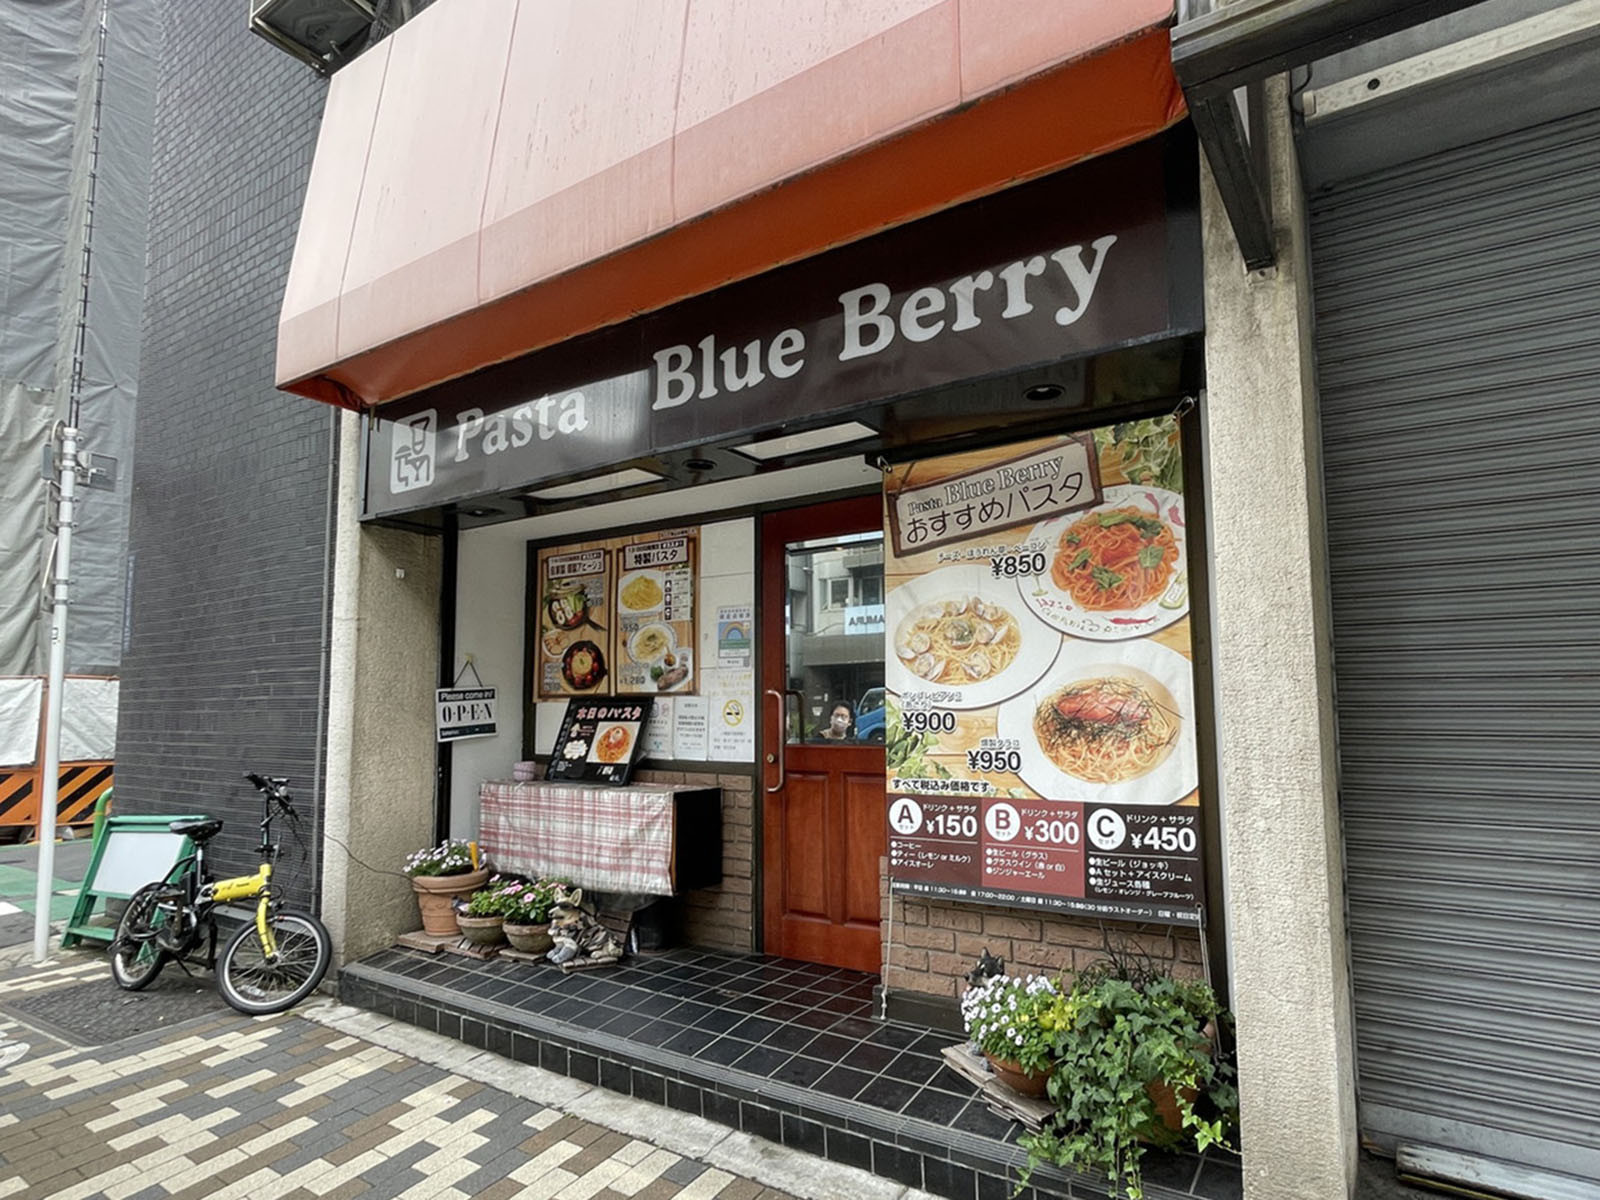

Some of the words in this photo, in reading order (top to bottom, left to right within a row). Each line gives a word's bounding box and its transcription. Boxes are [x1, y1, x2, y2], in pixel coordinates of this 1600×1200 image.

[455, 392, 589, 462] Pasta
[652, 328, 805, 411] Blue
[838, 234, 1118, 361] Berry
[907, 497, 943, 516] Pasta
[944, 479, 995, 506] Blue
[997, 456, 1063, 489] Berry
[907, 472, 1083, 544] おすすめパスタ
[634, 549, 678, 565] 特製パスタ
[991, 553, 1046, 576] ¥850
[576, 706, 642, 720] 本日のパスタ
[903, 712, 955, 731] ¥900
[968, 750, 1020, 770] ¥950
[897, 804, 914, 823] A
[995, 809, 1011, 829] B
[926, 814, 977, 837] ¥150
[1024, 820, 1080, 845] ¥300
[1096, 815, 1115, 838] C
[1131, 827, 1197, 852] ¥450
